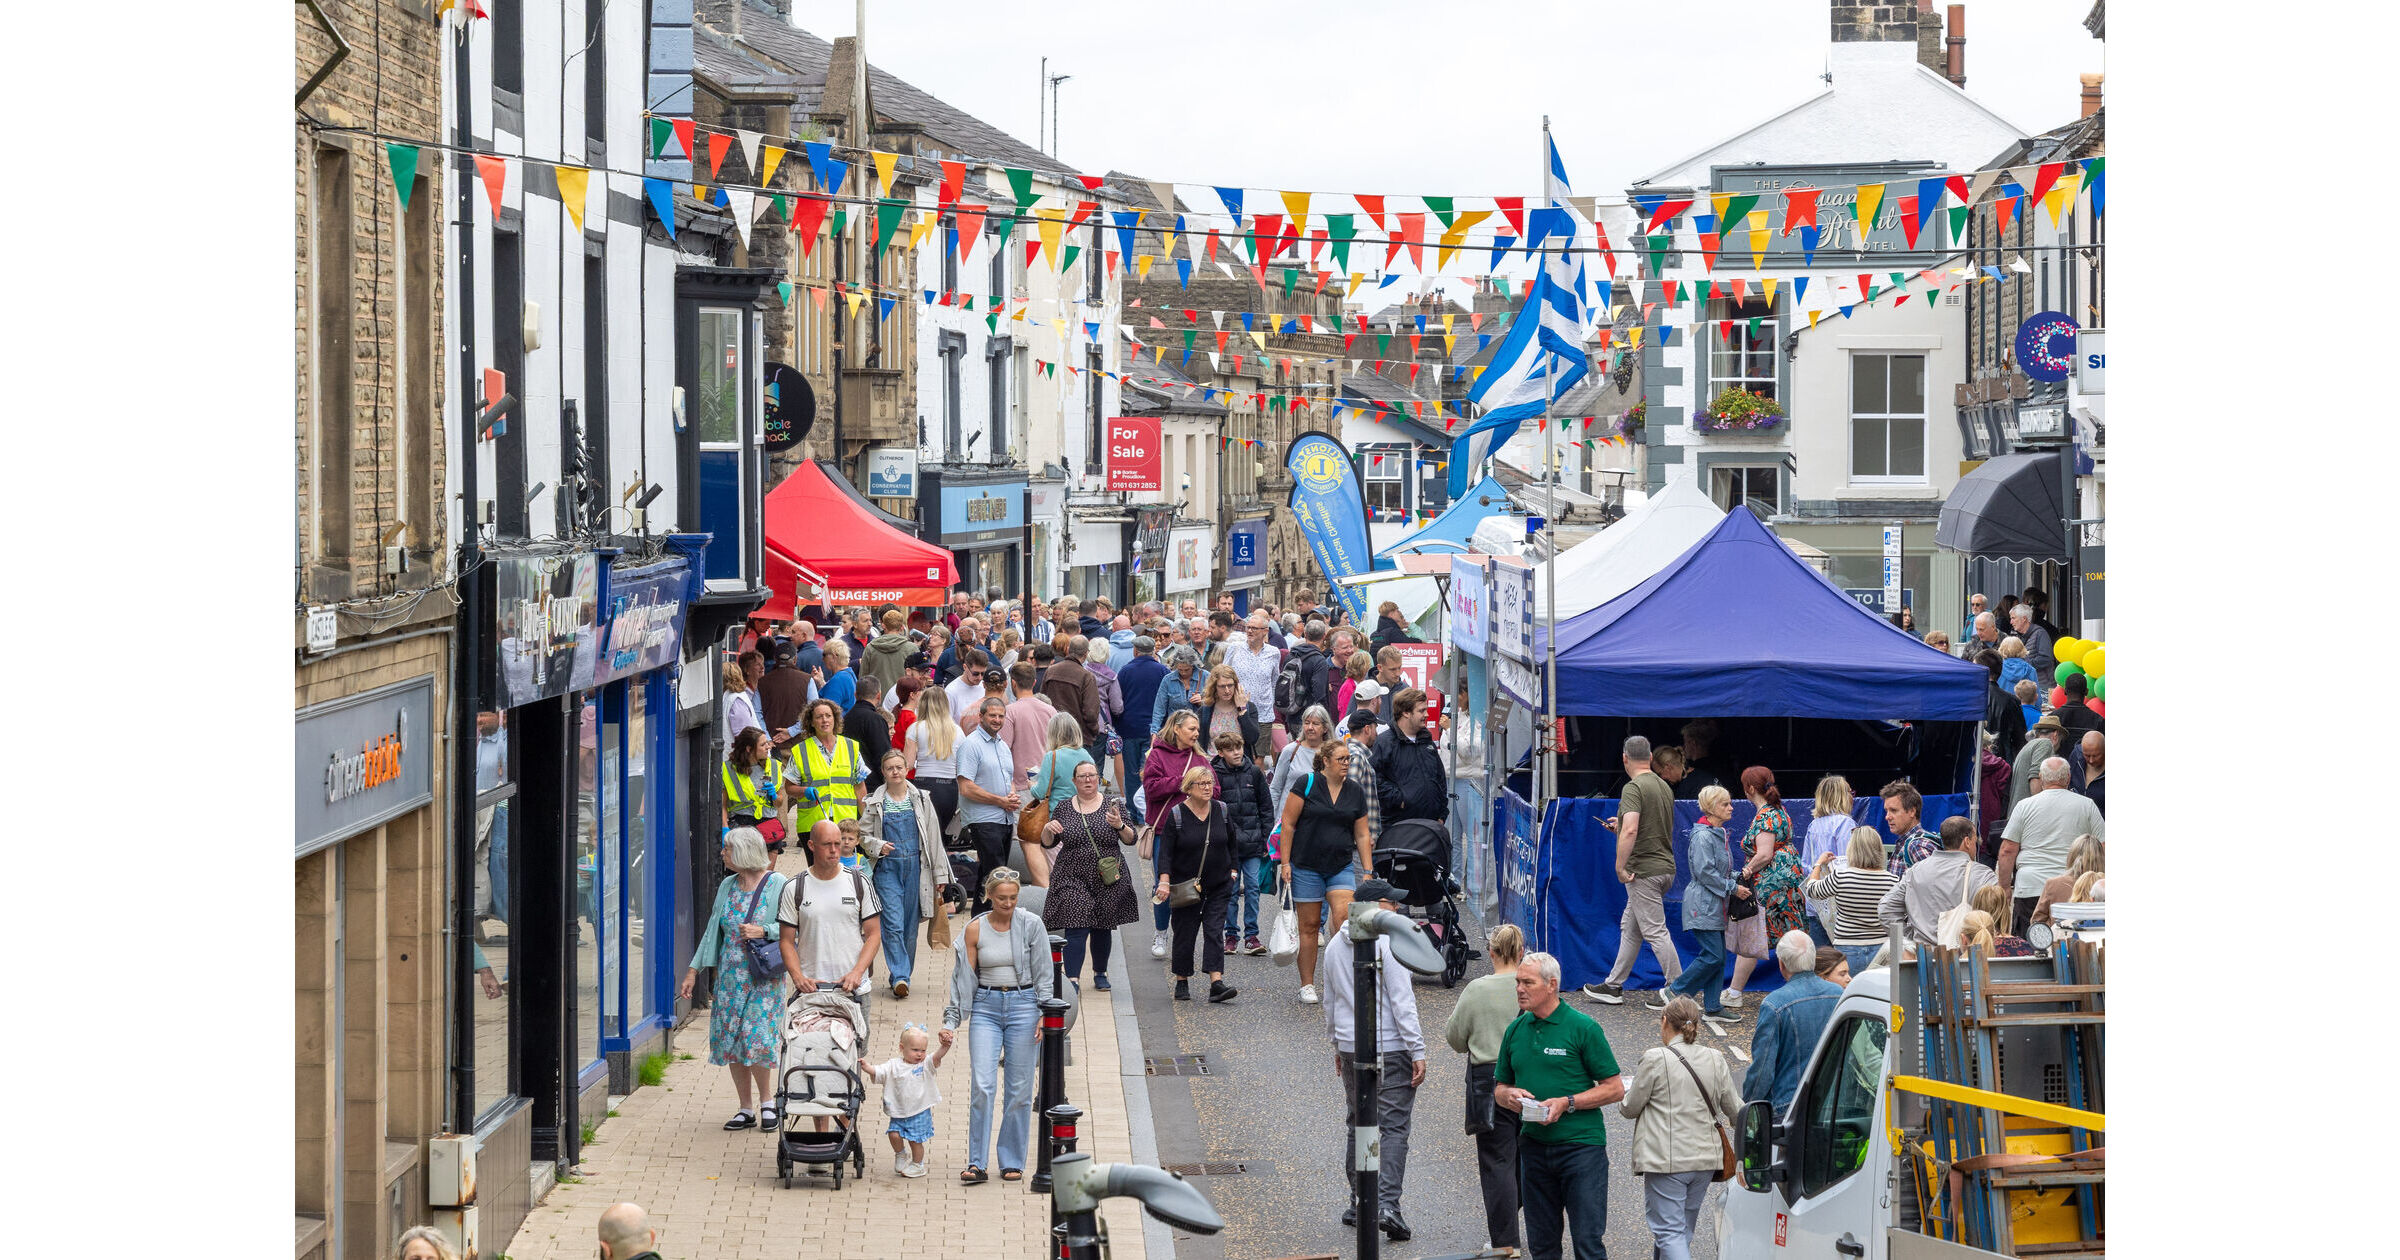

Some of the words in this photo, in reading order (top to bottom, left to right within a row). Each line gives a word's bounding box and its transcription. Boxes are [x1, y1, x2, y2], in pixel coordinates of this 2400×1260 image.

[1754, 180, 1781, 190] THE
[1852, 241, 1898, 251] OTEL
[764, 420, 791, 430] bble
[764, 431, 791, 442] nack
[1113, 427, 1139, 439] For
[1112, 445, 1145, 458] Sale
[816, 590, 869, 601] SUSAGE
[871, 591, 903, 601] SHOP
[1854, 593, 1874, 605] TO
